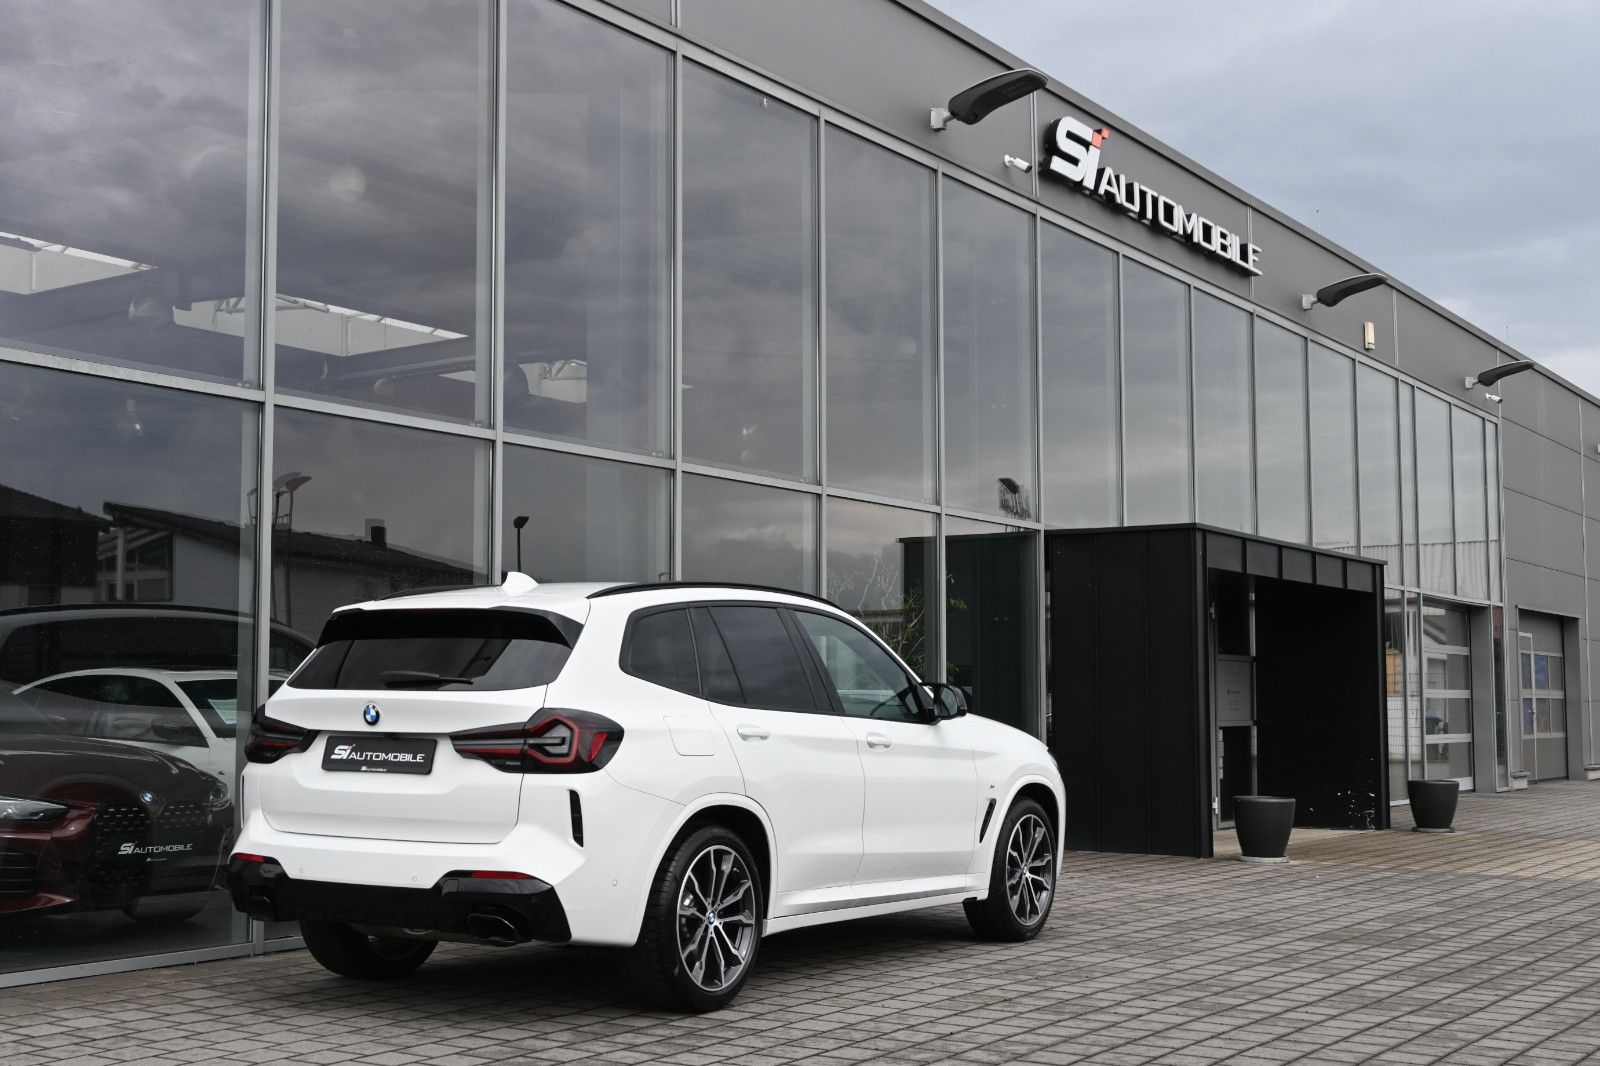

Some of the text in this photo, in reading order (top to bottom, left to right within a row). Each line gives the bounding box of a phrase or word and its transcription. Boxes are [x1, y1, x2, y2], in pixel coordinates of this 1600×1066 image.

[1098, 166, 1263, 276] AUTOMOBILE
[348, 751, 426, 763] AUTOMOBILE
[133, 843, 193, 854] AUTOMOBILE
